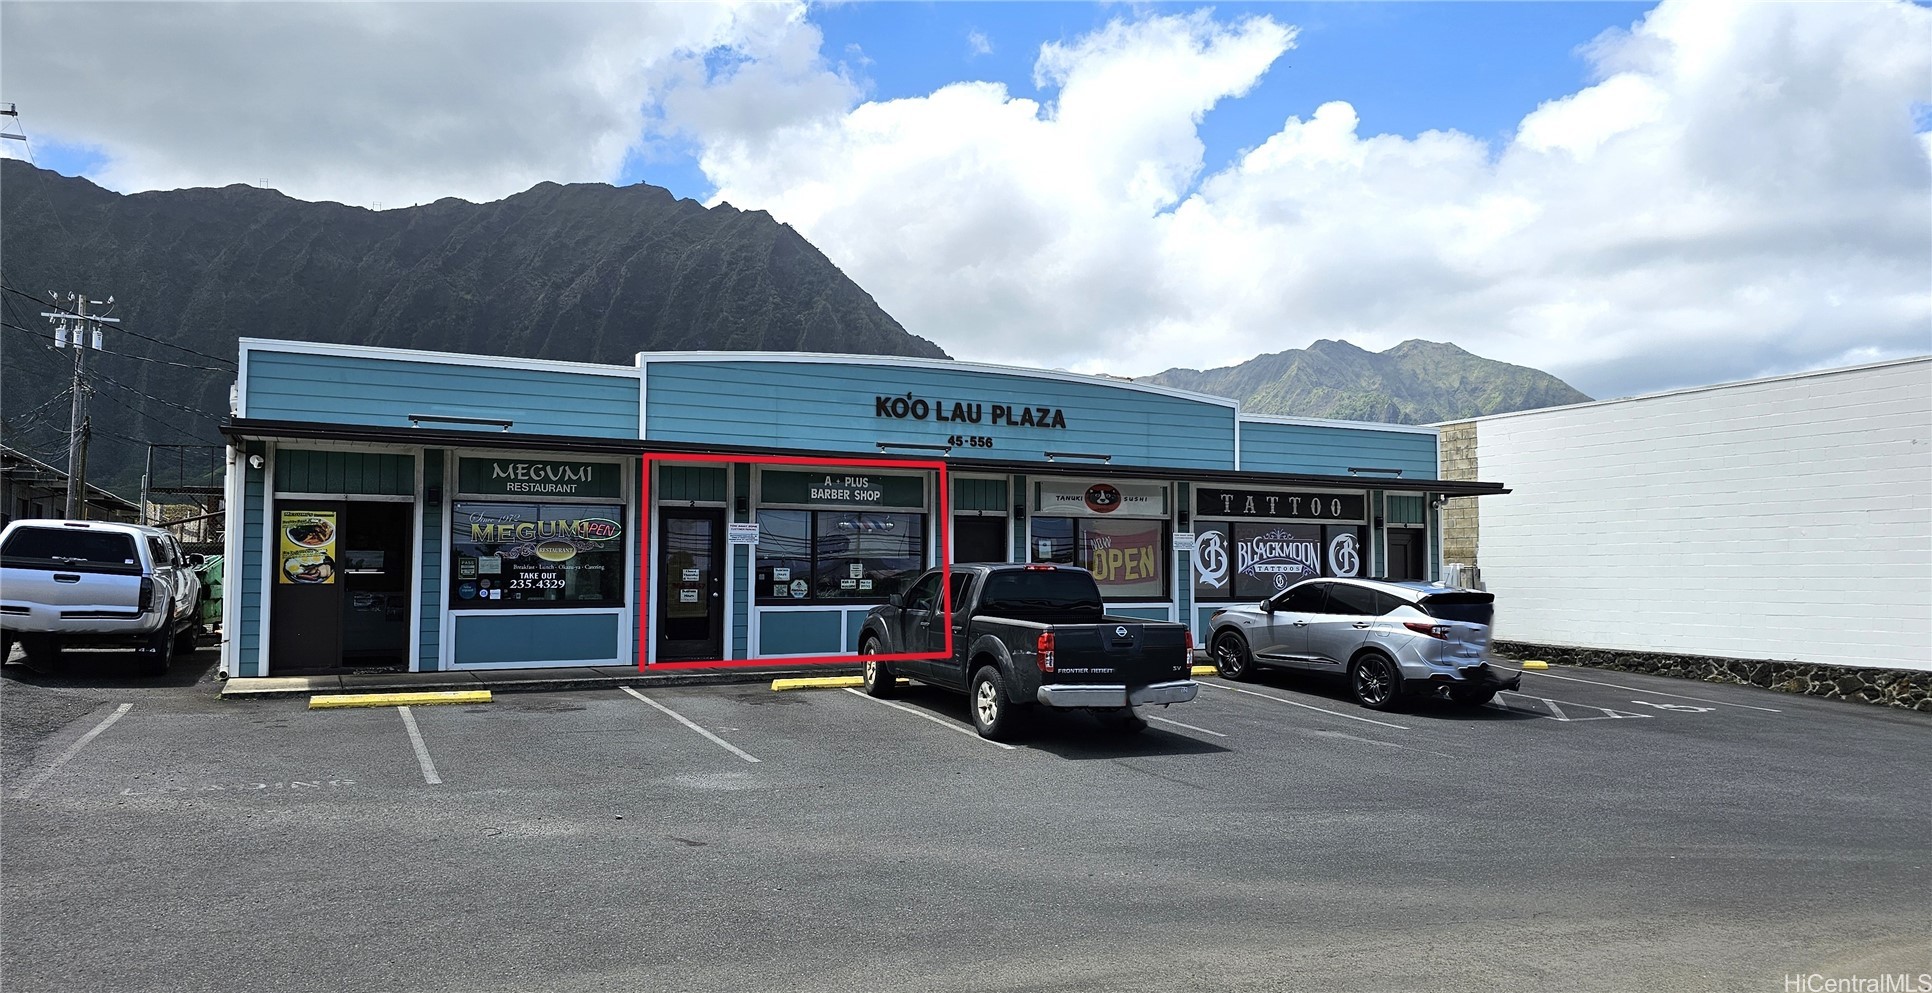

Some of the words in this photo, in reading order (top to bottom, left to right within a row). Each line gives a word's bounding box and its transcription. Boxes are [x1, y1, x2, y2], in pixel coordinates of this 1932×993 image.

[936, 401, 982, 424] LAU
[991, 404, 1067, 429] PLAZA
[948, 435, 993, 448] 45-556
[492, 462, 592, 482] MEGUMI
[507, 483, 577, 493] RESTAURANT
[824, 476, 832, 487] A
[844, 477, 869, 488] PLUS
[811, 489, 850, 500] BARBER
[854, 490, 881, 501] SHOP
[1220, 494, 1342, 517] TATTOO
[470, 511, 495, 523] Since
[471, 519, 589, 543] MEGUMI
[1090, 536, 1112, 550] NOW
[1238, 536, 1321, 574] BLACKMOON
[1092, 545, 1155, 581] OPEN
[520, 572, 539, 580] TAKE
[541, 572, 557, 580] OUT
[509, 580, 566, 589] 235.4329
